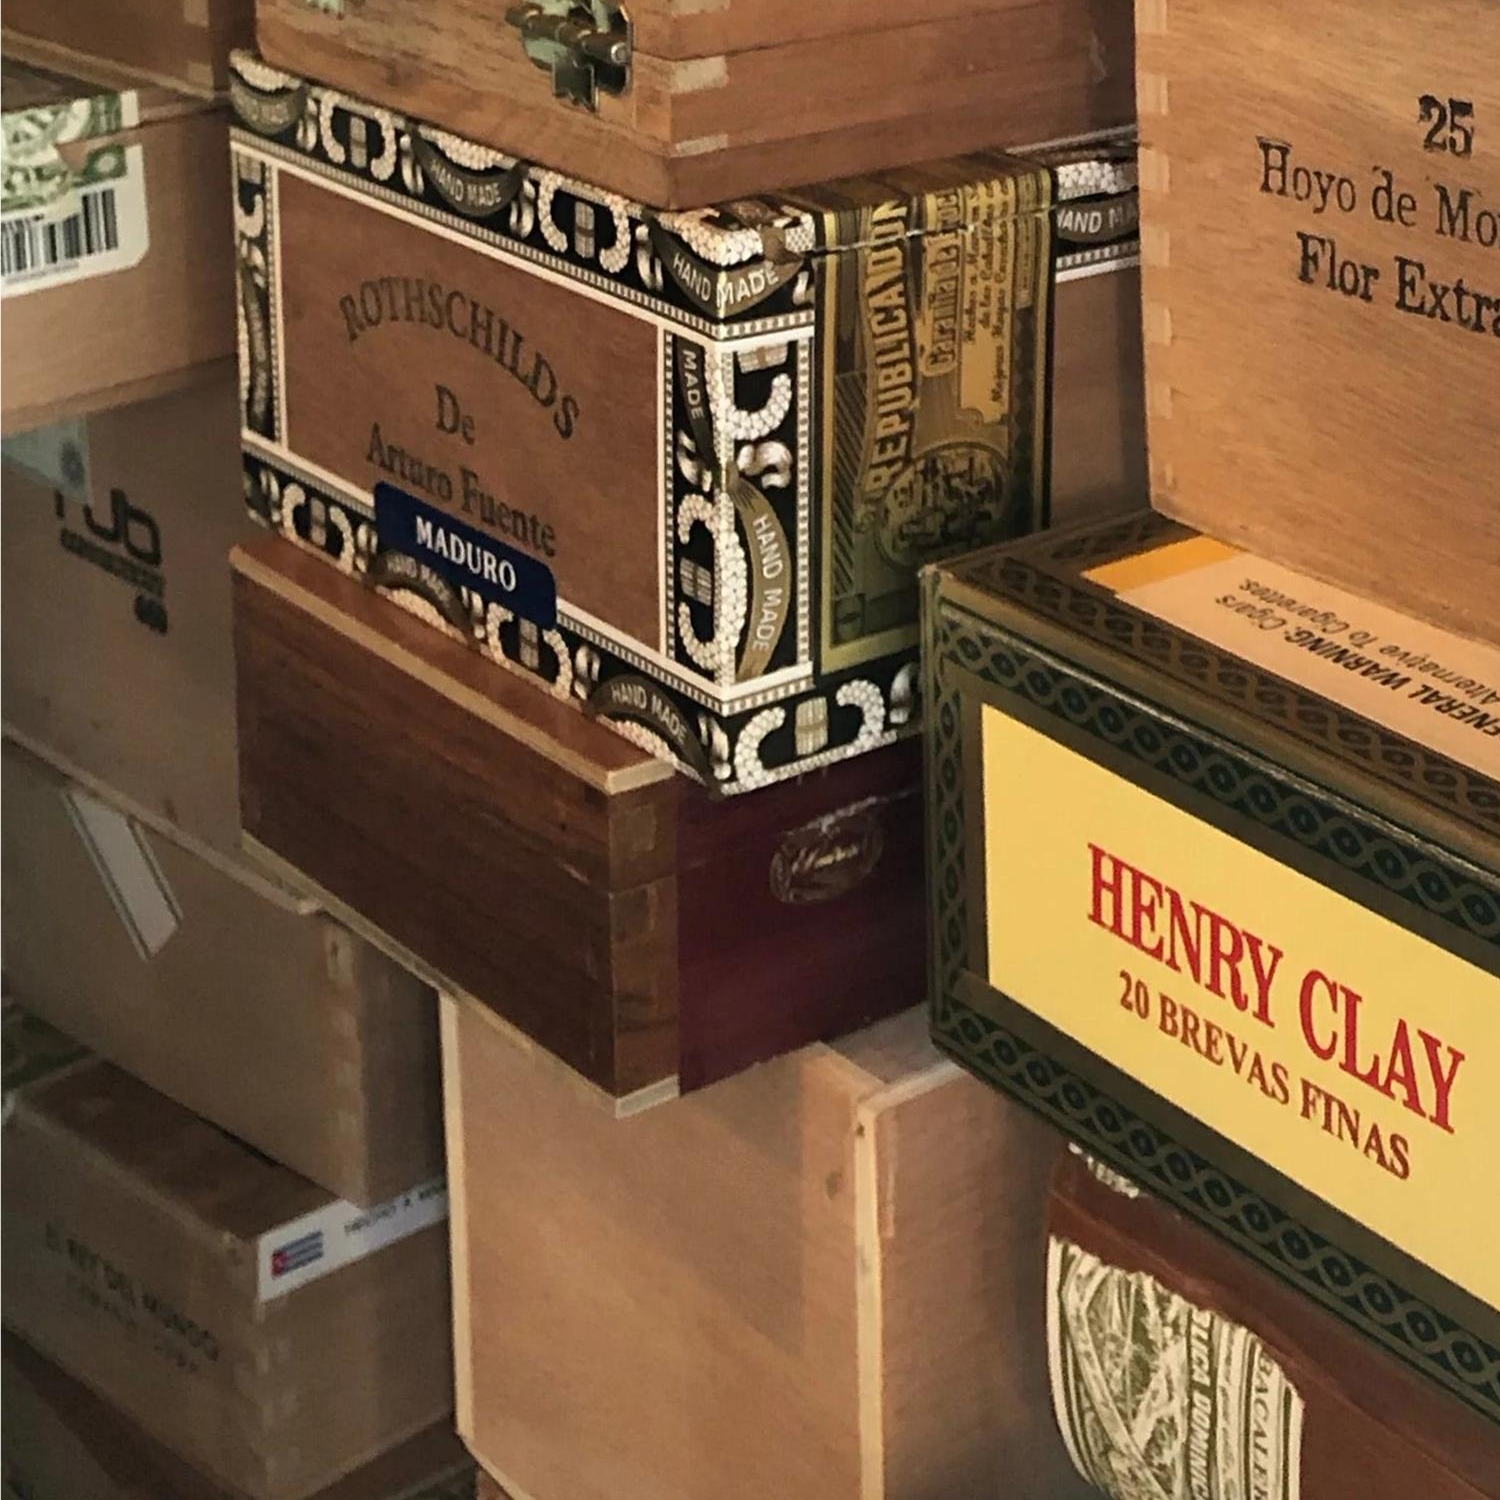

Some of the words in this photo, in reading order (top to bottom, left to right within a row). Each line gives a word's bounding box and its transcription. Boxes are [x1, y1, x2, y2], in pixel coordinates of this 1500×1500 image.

[1416, 94, 1475, 158] 25
[430, 158, 465, 202] HAND
[466, 181, 502, 207] MADE
[1256, 136, 1358, 214] Hoyo
[1371, 163, 1418, 227] de
[672, 252, 712, 302] HAND
[716, 259, 779, 308] MADE
[1297, 231, 1380, 302] Flor
[338, 275, 580, 441] ROTHSCHILDS
[681, 349, 704, 421] MADE
[864, 282, 913, 492] REPUBLICA
[434, 383, 476, 446] De
[365, 421, 454, 501] Arturo
[459, 463, 556, 558] Fuente
[415, 515, 517, 592] MADURO
[752, 513, 783, 580] HAND
[752, 587, 783, 651] MADE
[1214, 593, 1288, 633] Cigars
[1348, 630, 1378, 650] To
[610, 681, 648, 710] HAND
[651, 694, 688, 746] MADE
[1087, 842, 1284, 1028] HENRY
[1299, 969, 1466, 1134] CLAY
[1118, 970, 1150, 1021] 20
[1158, 992, 1291, 1105] BREVAS
[1299, 1077, 1411, 1181] FINAS
